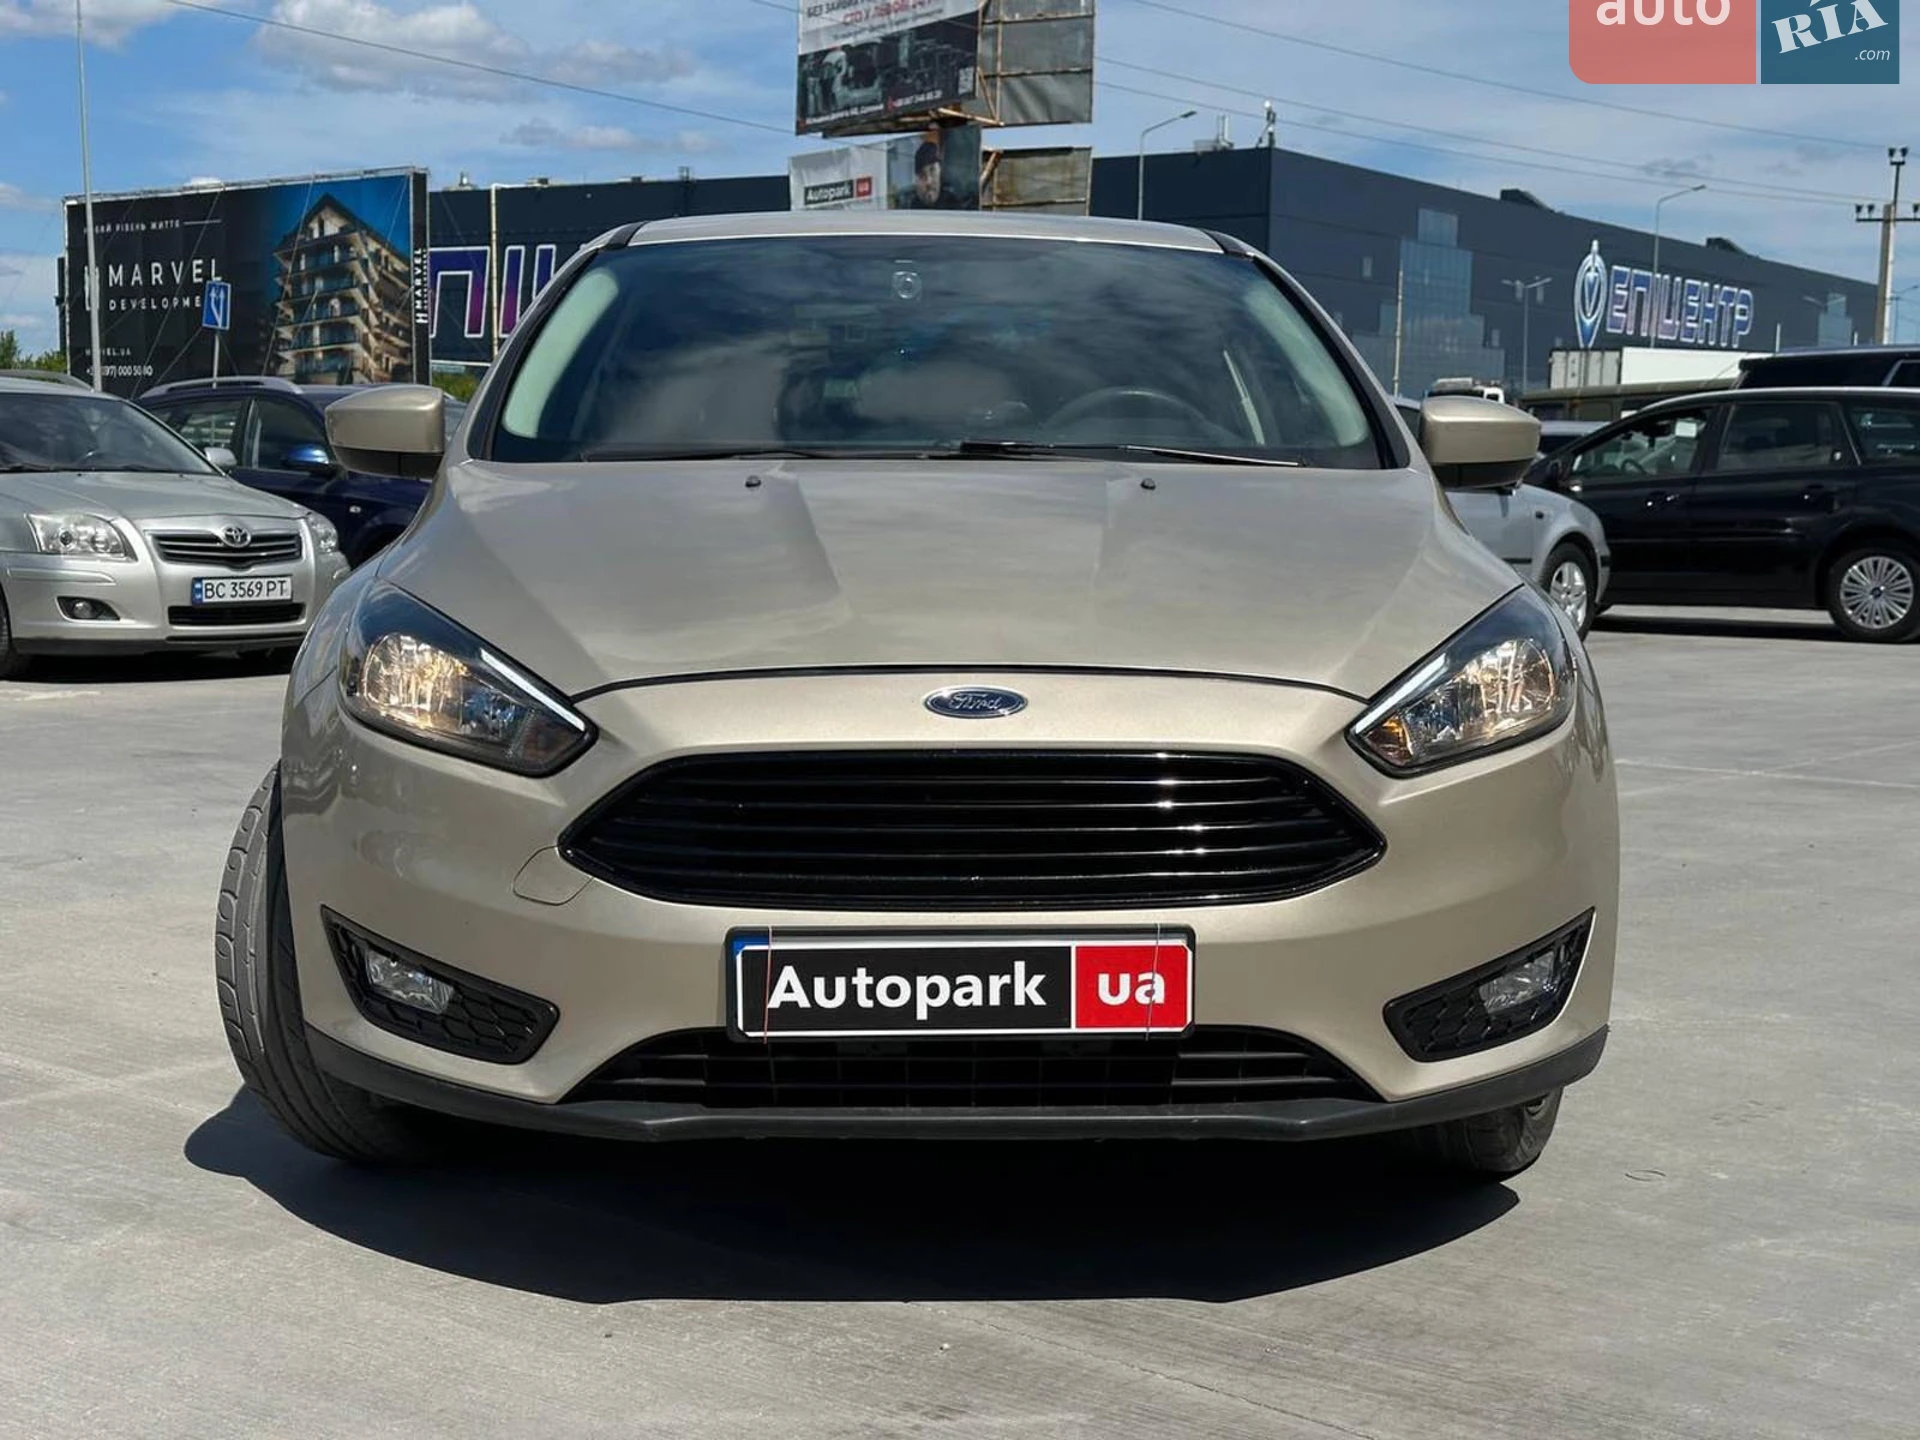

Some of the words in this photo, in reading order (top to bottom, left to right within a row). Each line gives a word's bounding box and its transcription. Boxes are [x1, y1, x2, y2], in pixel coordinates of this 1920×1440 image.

[108, 258, 222, 288] MARVEL
[108, 295, 202, 311] DEVELOPME
[204, 582, 226, 599] BC
[230, 581, 263, 598] 3569
[266, 580, 287, 597] PT
[949, 692, 1003, 709] Ford
[767, 960, 1047, 1021] Autopark
[1096, 971, 1166, 1006] ua
